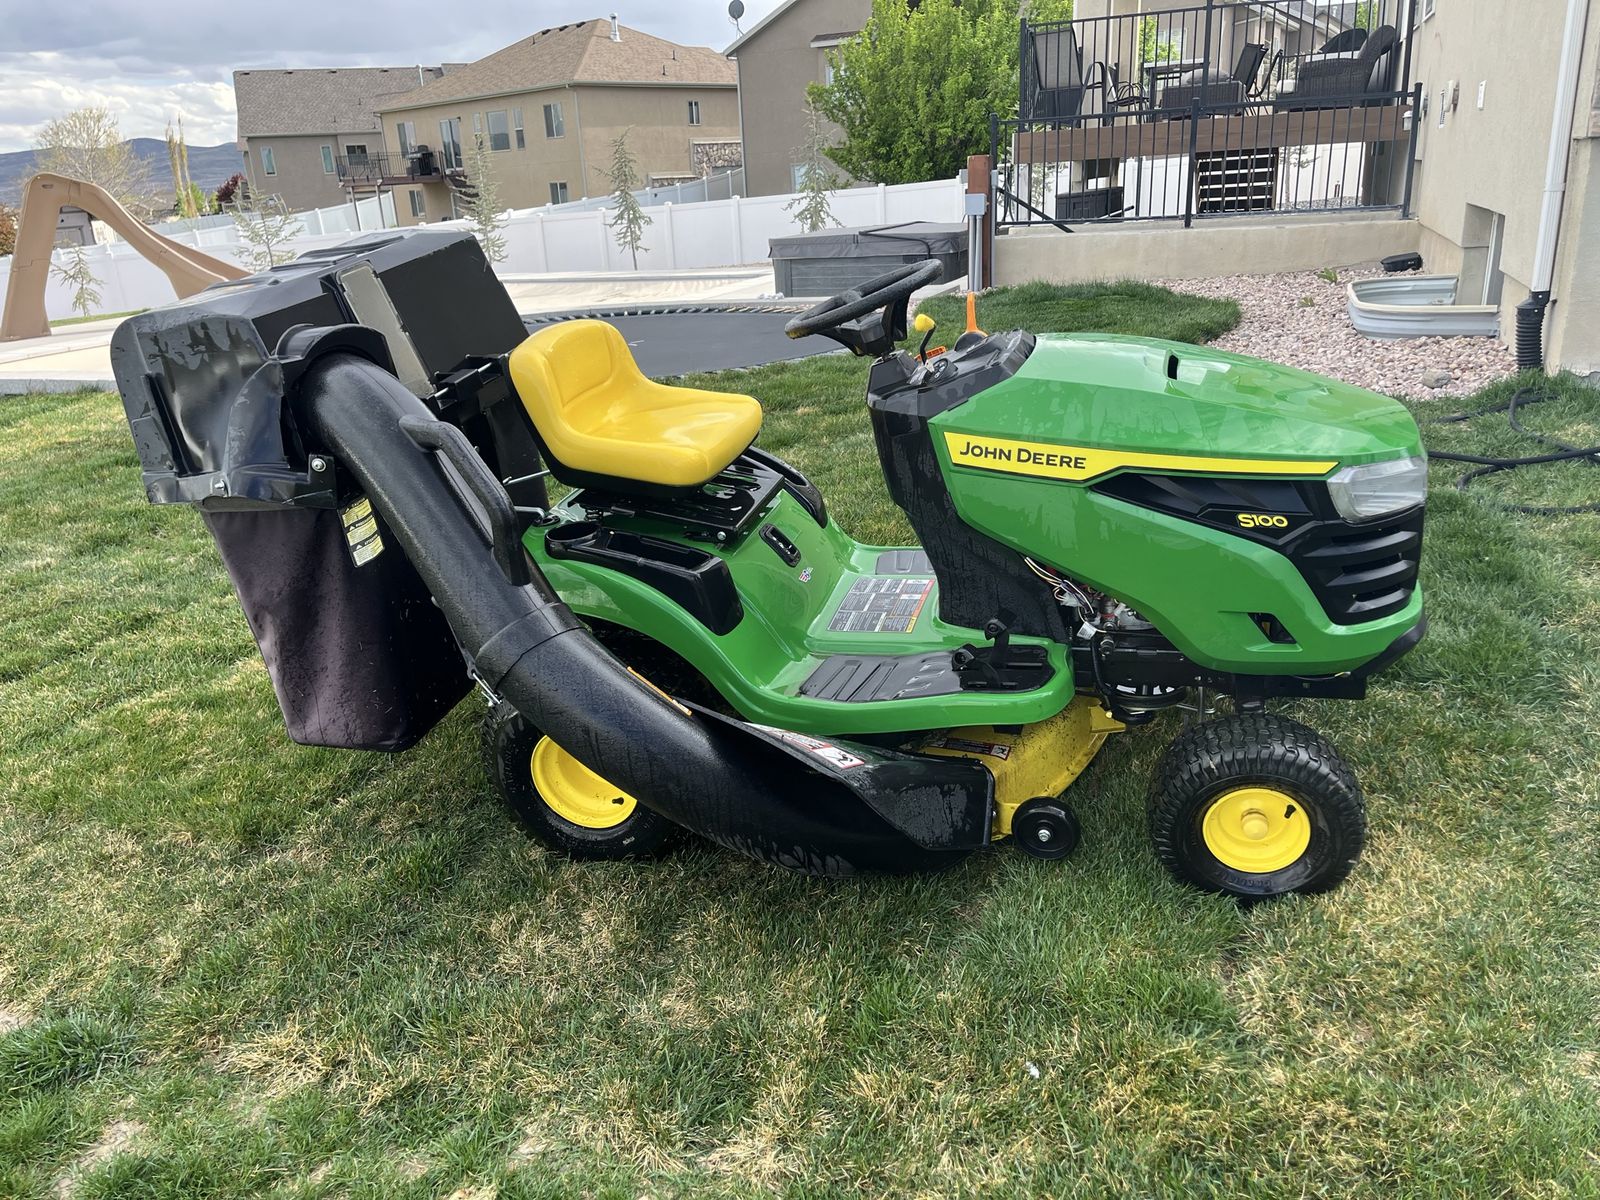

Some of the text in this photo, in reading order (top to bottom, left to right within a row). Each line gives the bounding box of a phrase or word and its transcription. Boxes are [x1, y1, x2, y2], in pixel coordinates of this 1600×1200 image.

[960, 441, 1087, 470] JOHN DEERE
[1237, 513, 1288, 528] S100
